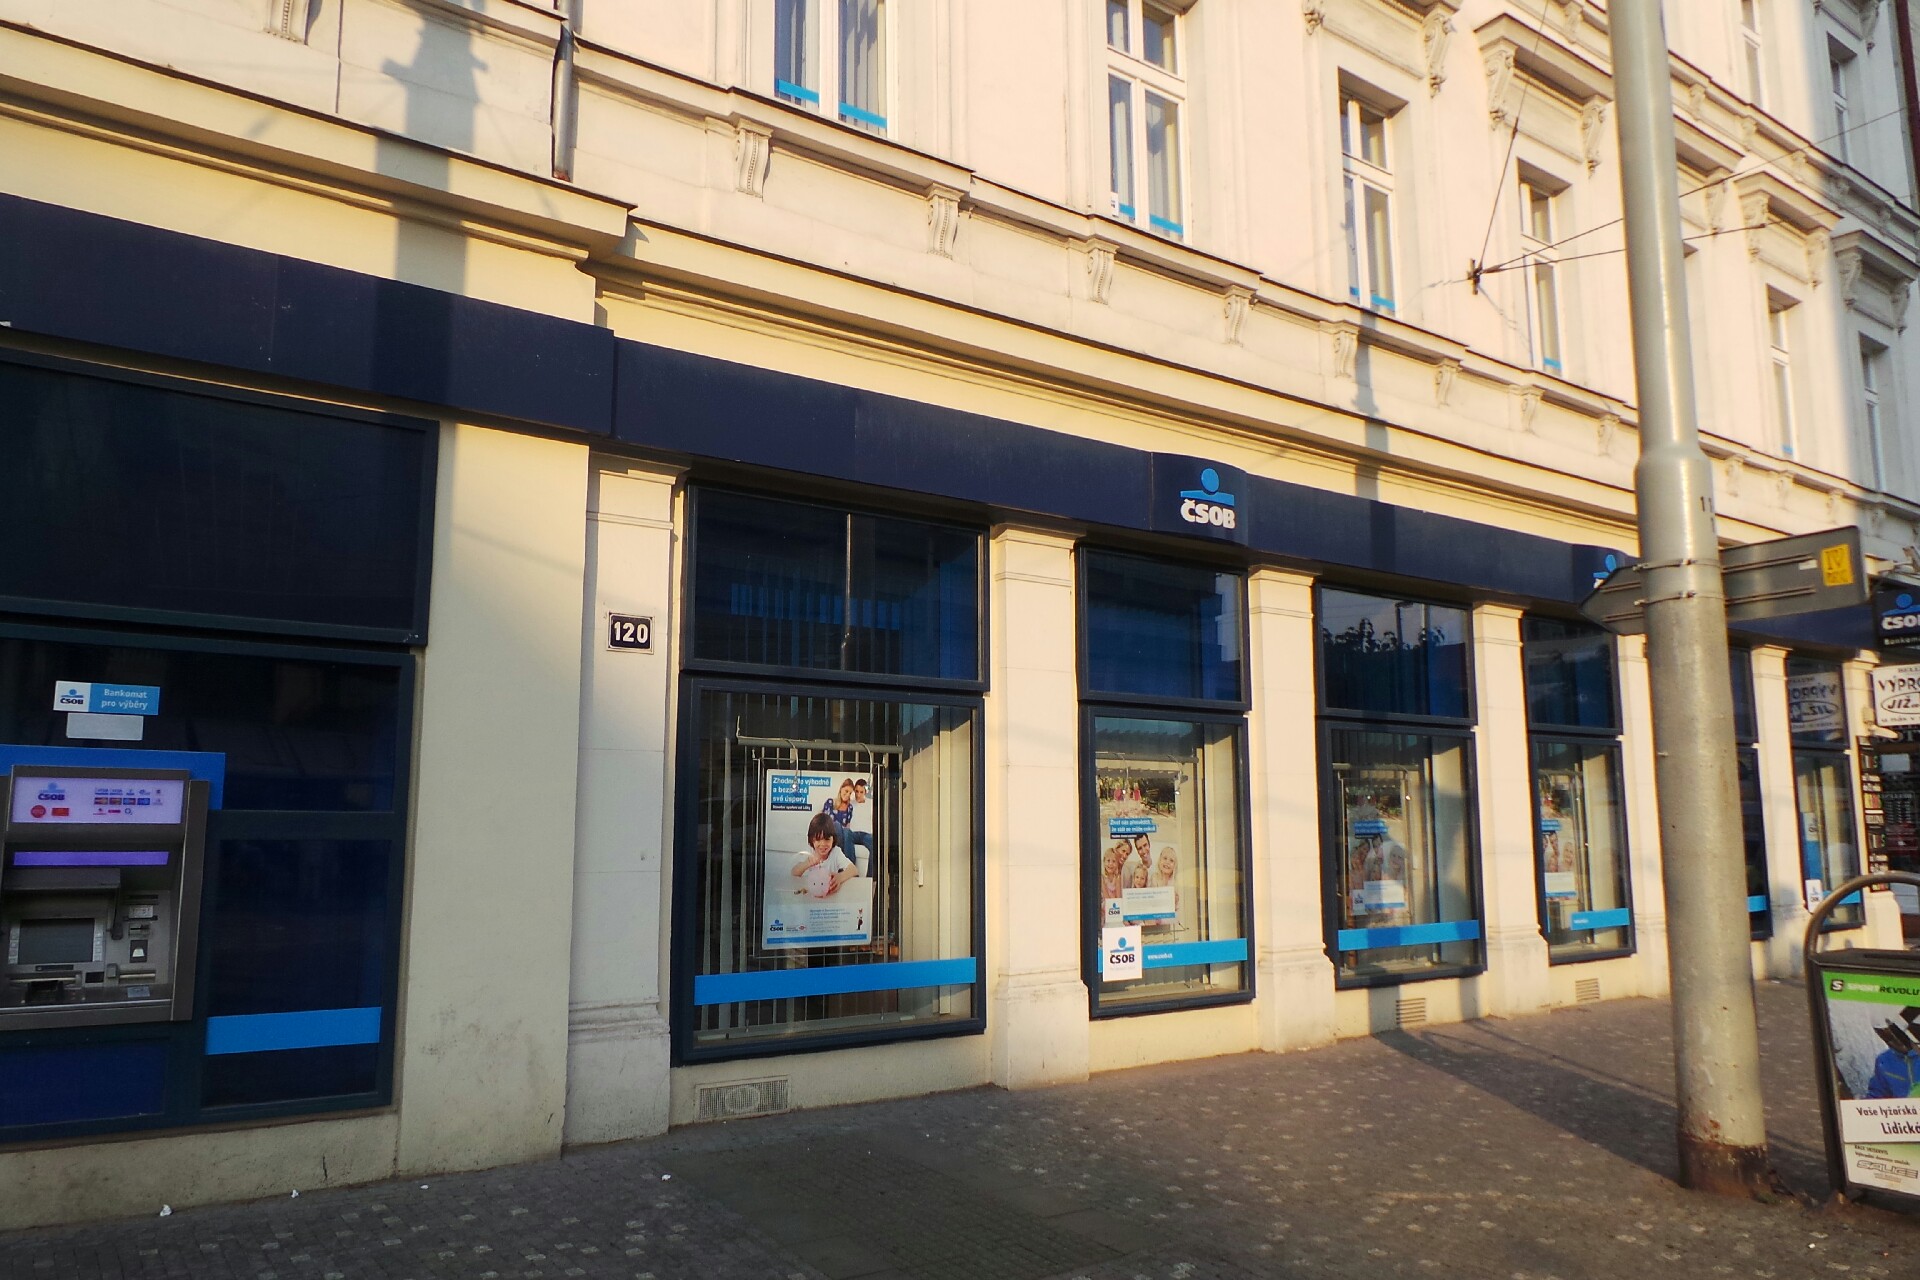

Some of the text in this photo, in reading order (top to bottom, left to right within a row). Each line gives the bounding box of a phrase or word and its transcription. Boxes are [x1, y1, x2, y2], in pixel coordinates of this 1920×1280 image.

[1180, 498, 1236, 530] ČSOB
[613, 621, 649, 643] 120
[104, 688, 147, 699] Bankomat
[60, 697, 84, 705] ČSOB
[101, 700, 116, 708] pro
[1887, 695, 1911, 709] JIŽ
[1110, 954, 1135, 964] ČSOB
[1856, 1105, 1918, 1119] Vaše lyžařská
